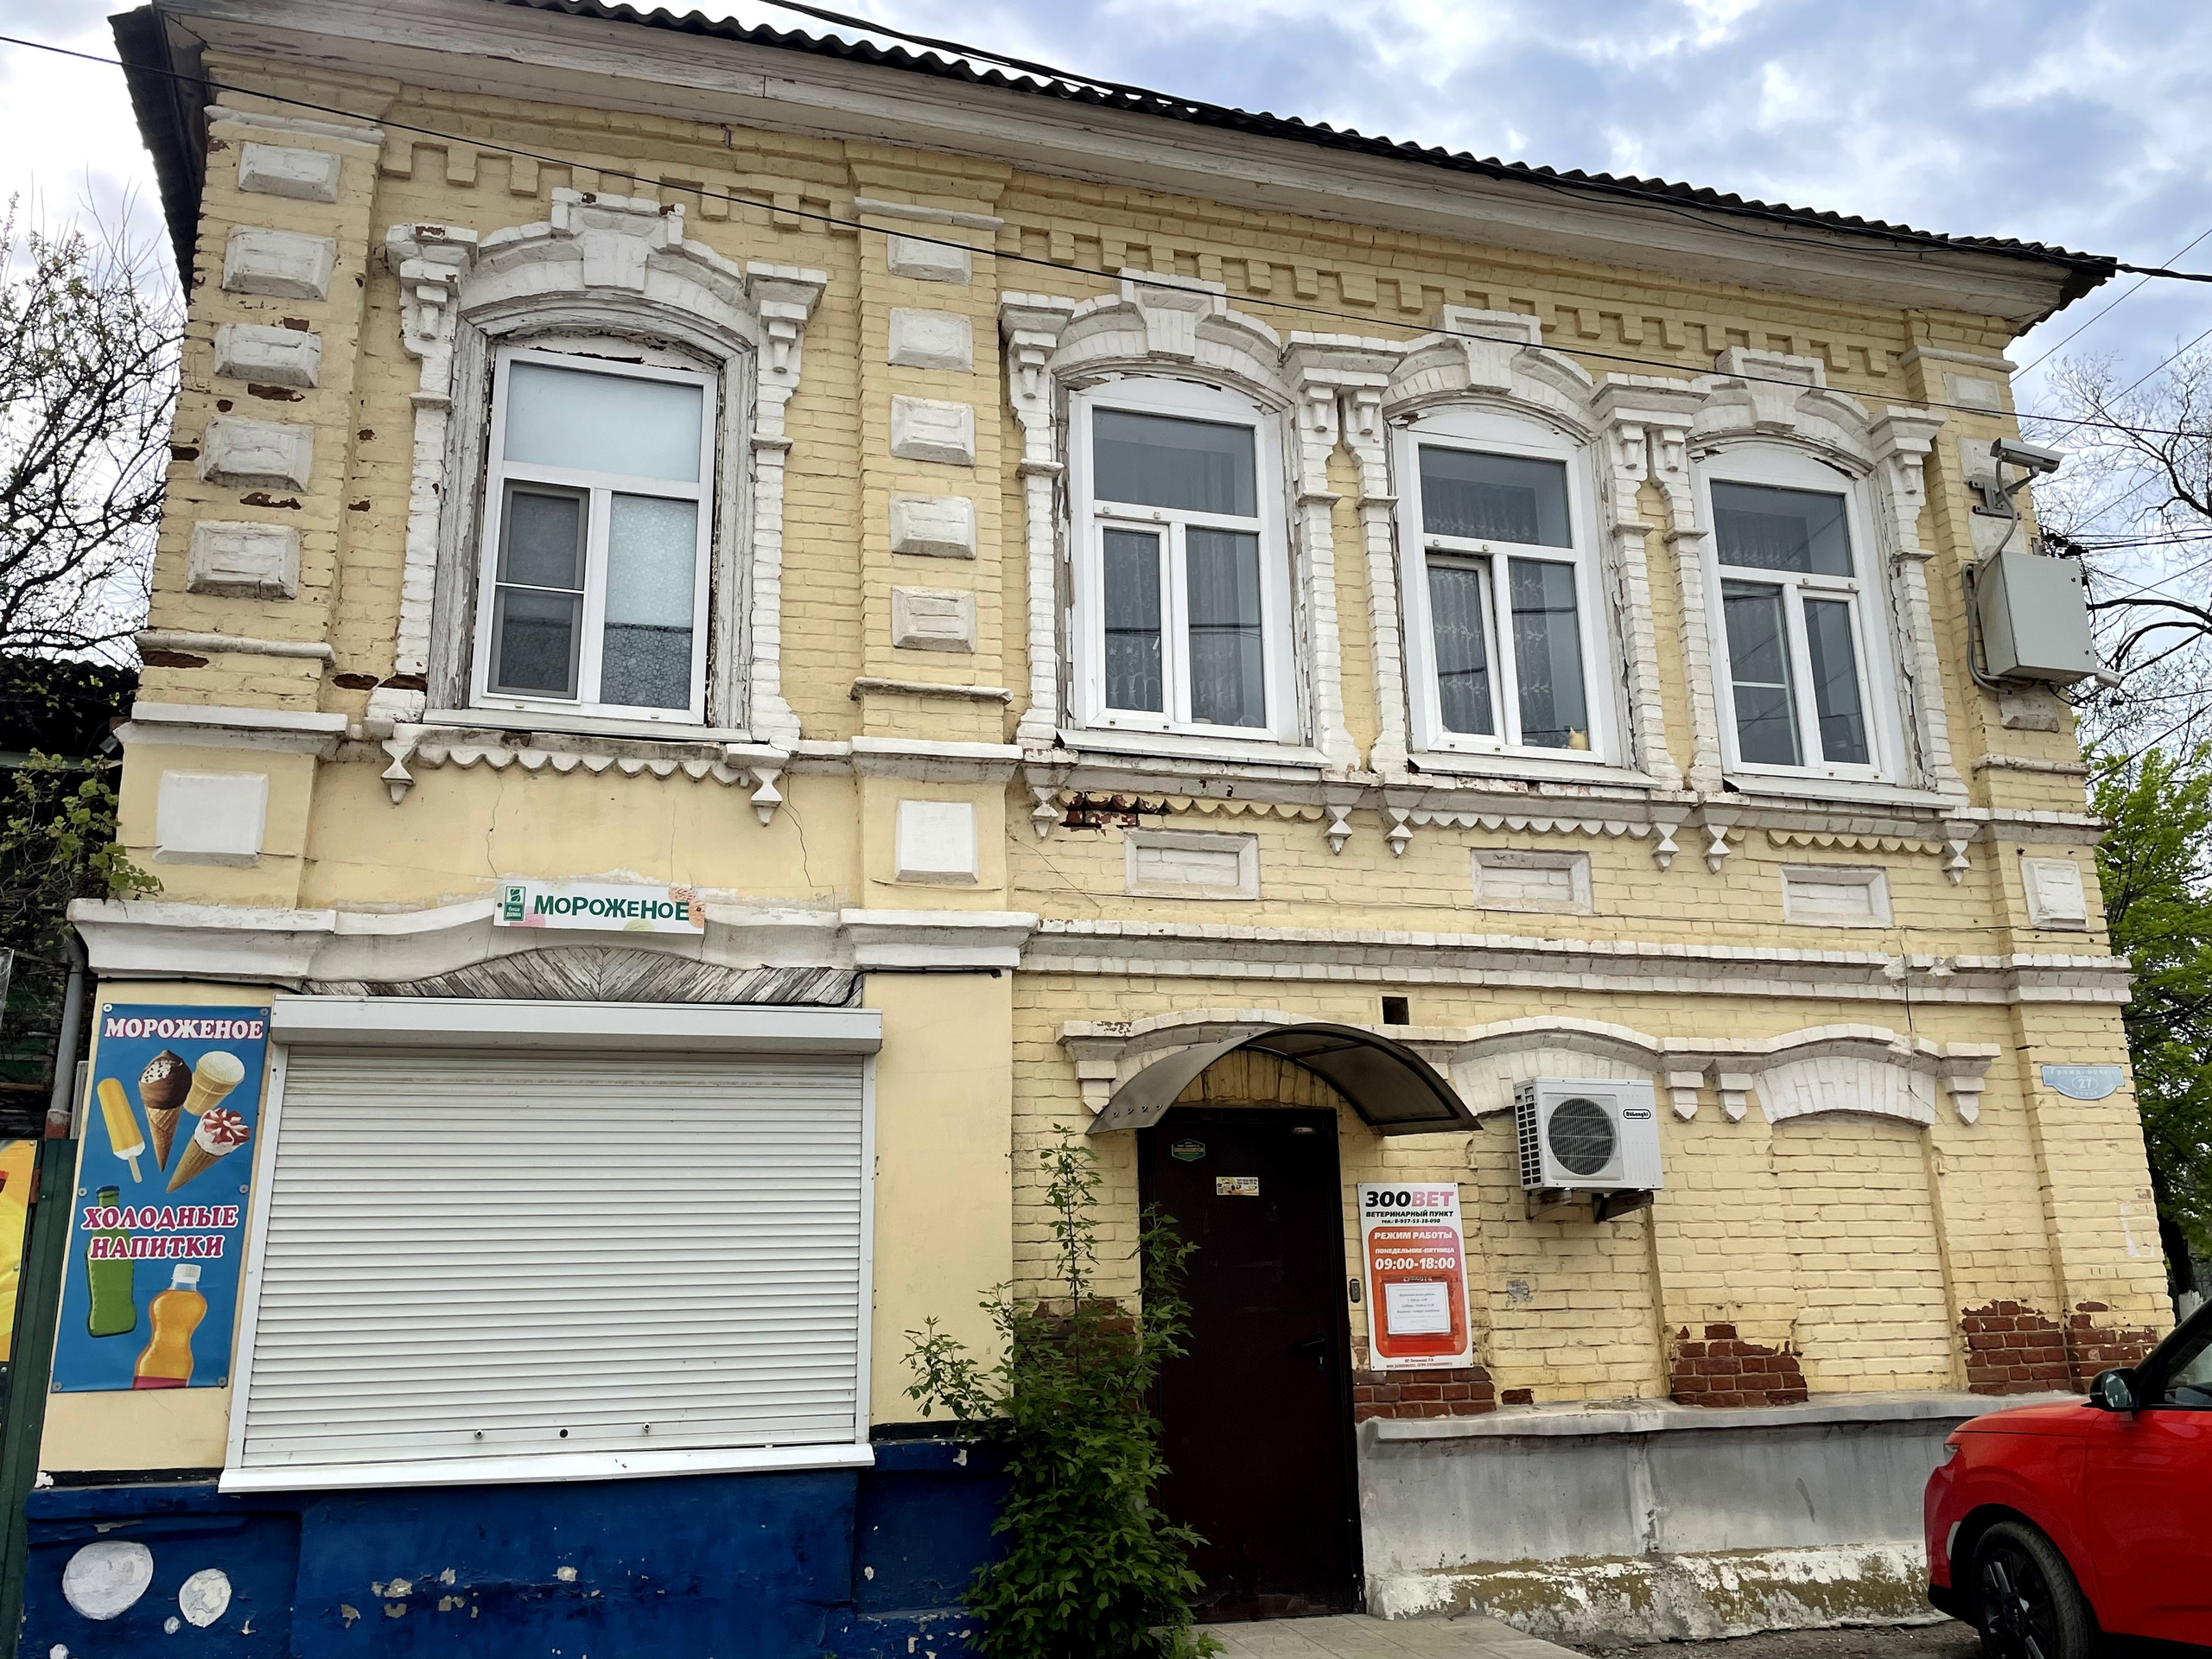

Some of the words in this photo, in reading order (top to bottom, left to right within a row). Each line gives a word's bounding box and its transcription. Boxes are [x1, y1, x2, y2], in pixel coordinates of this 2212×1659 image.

[533, 894, 690, 921] МОРОЖЕНОЕ
[104, 1017, 264, 1039] МОРОЖЕНОЕ
[2077, 1078, 2092, 1089] 27
[1365, 1191, 1454, 1207] ЗООВЕТ
[81, 1205, 238, 1232] ХОЛОДНЫЕ
[1374, 1231, 1411, 1240] РЕЖИМ
[89, 1236, 225, 1259] НАПИТКИ
[1375, 1257, 1456, 1270] 09:00-18:00
